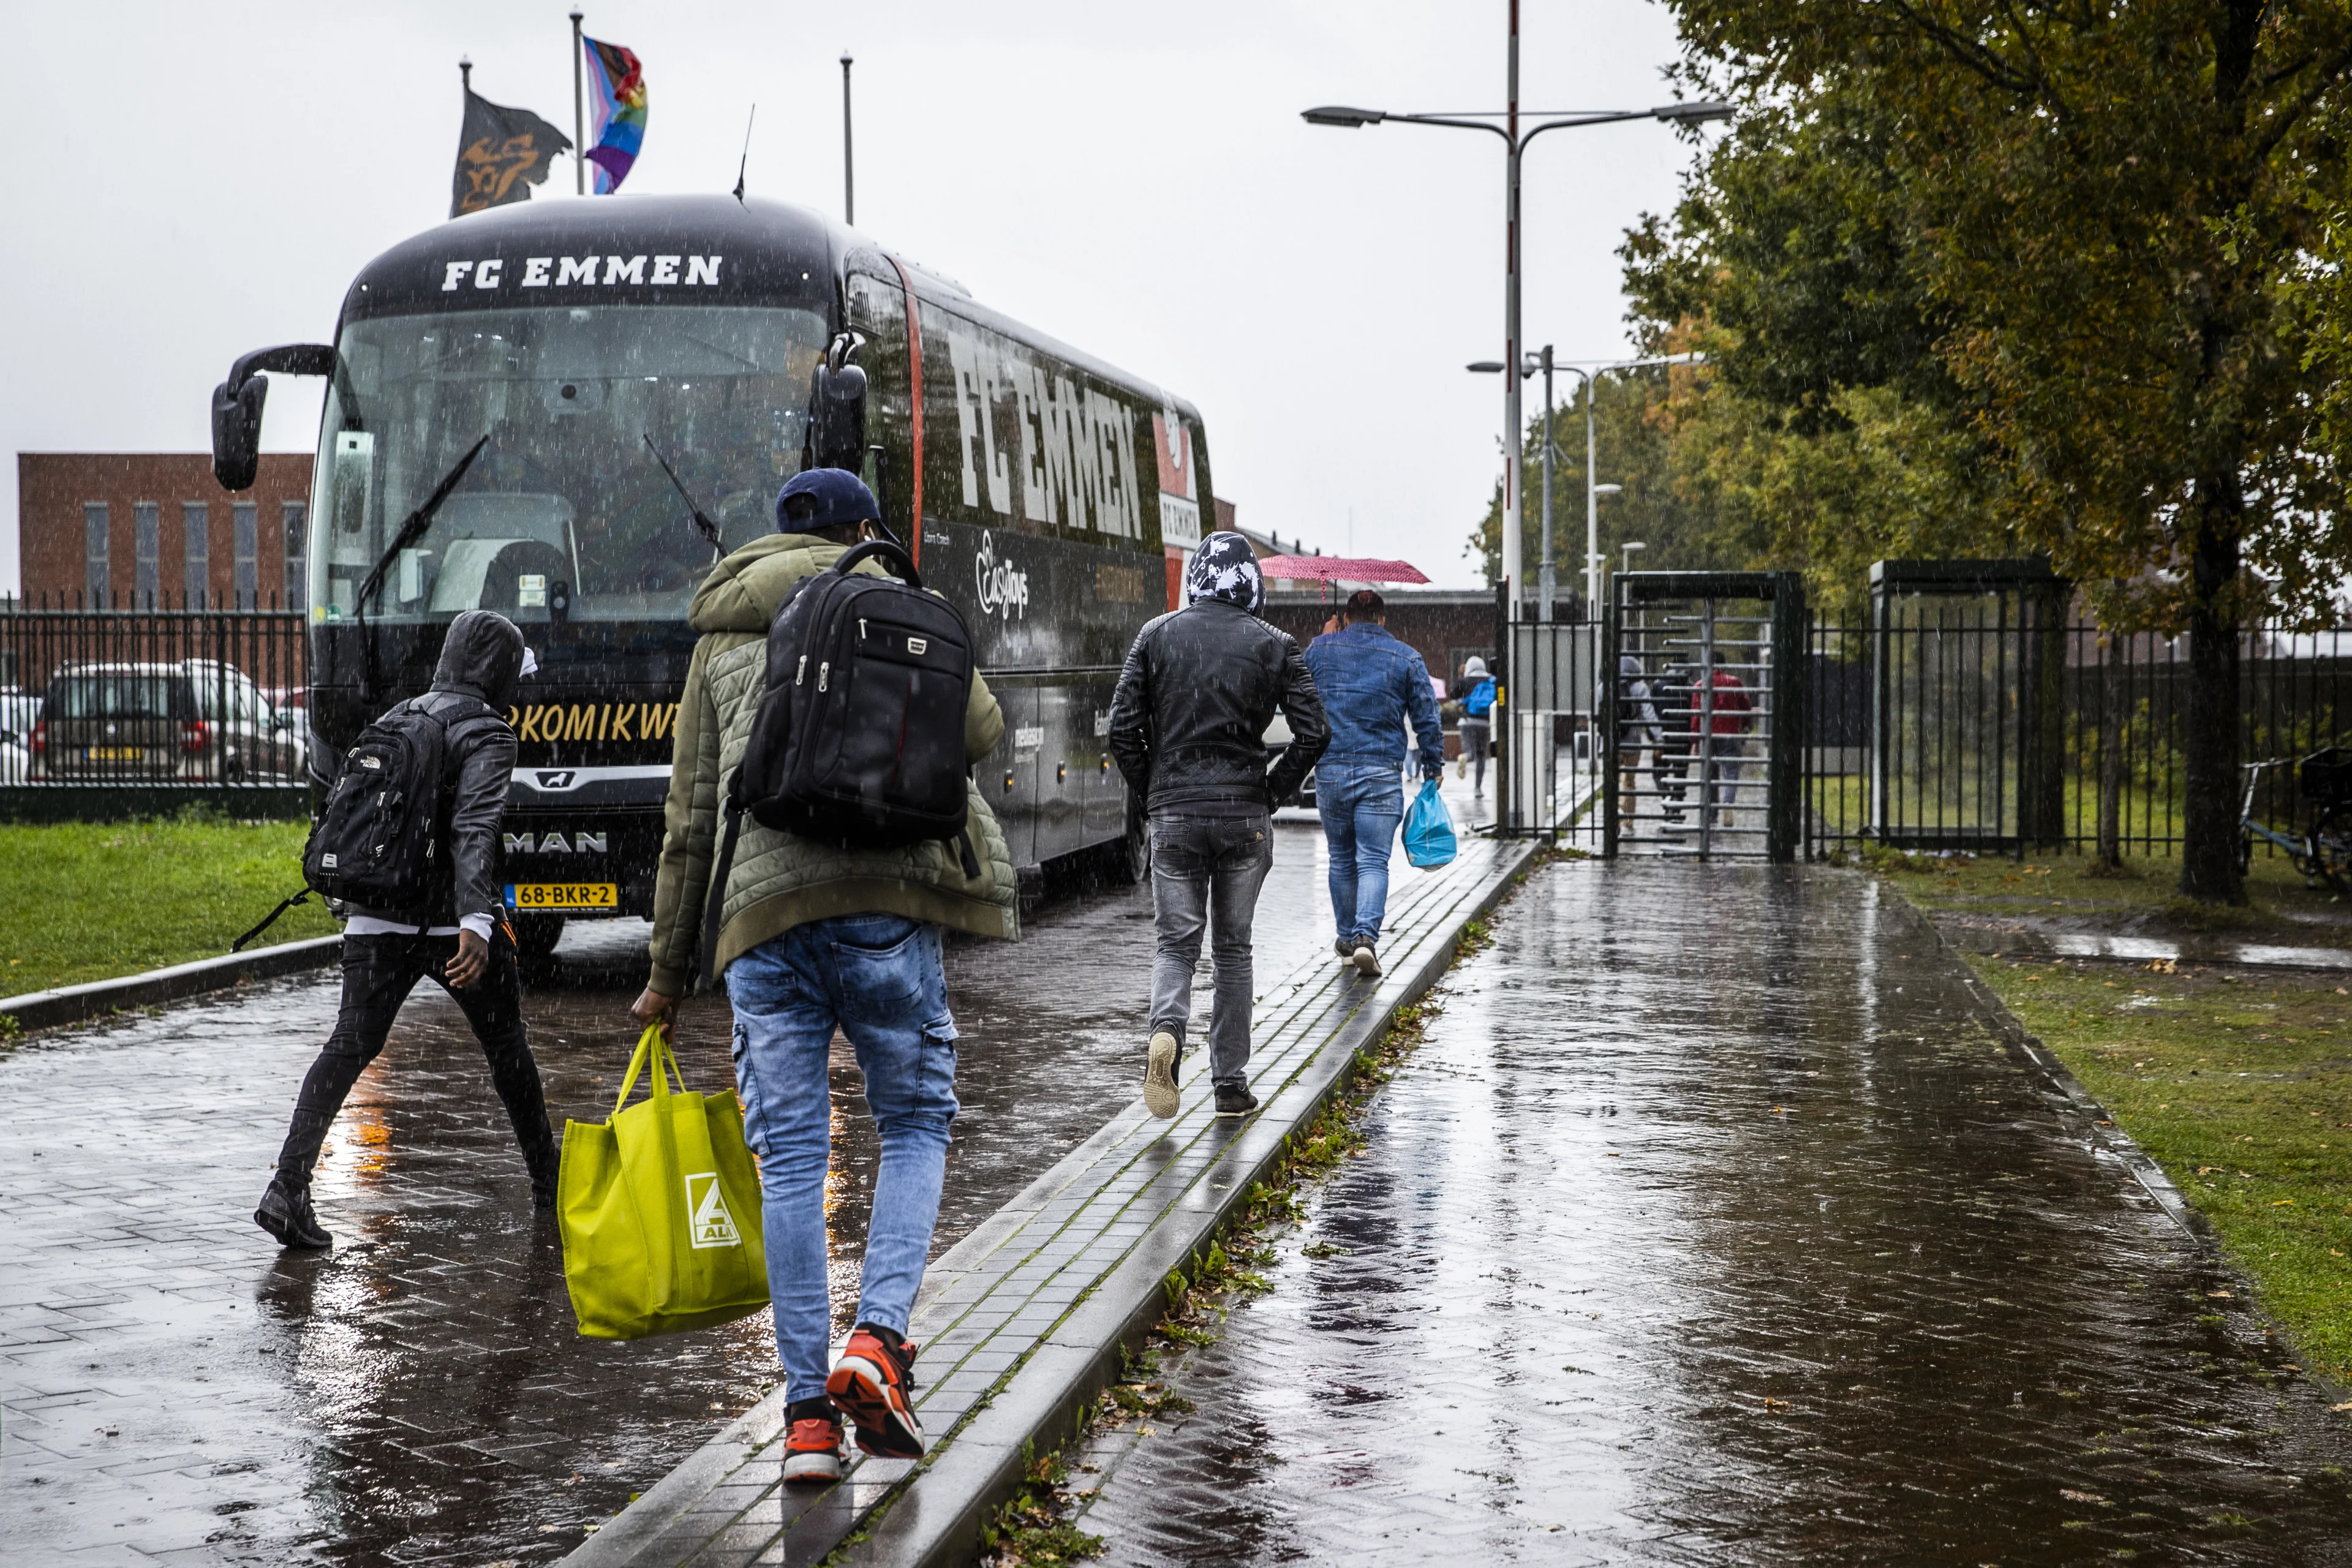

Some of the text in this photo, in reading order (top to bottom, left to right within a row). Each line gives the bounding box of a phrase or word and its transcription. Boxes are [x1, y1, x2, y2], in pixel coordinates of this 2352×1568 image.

[442, 255, 723, 292] FC EMMEN
[948, 330, 1142, 541] FC EMMEN
[503, 832, 607, 853] MAN
[521, 886, 610, 903] 68-BKR-2
